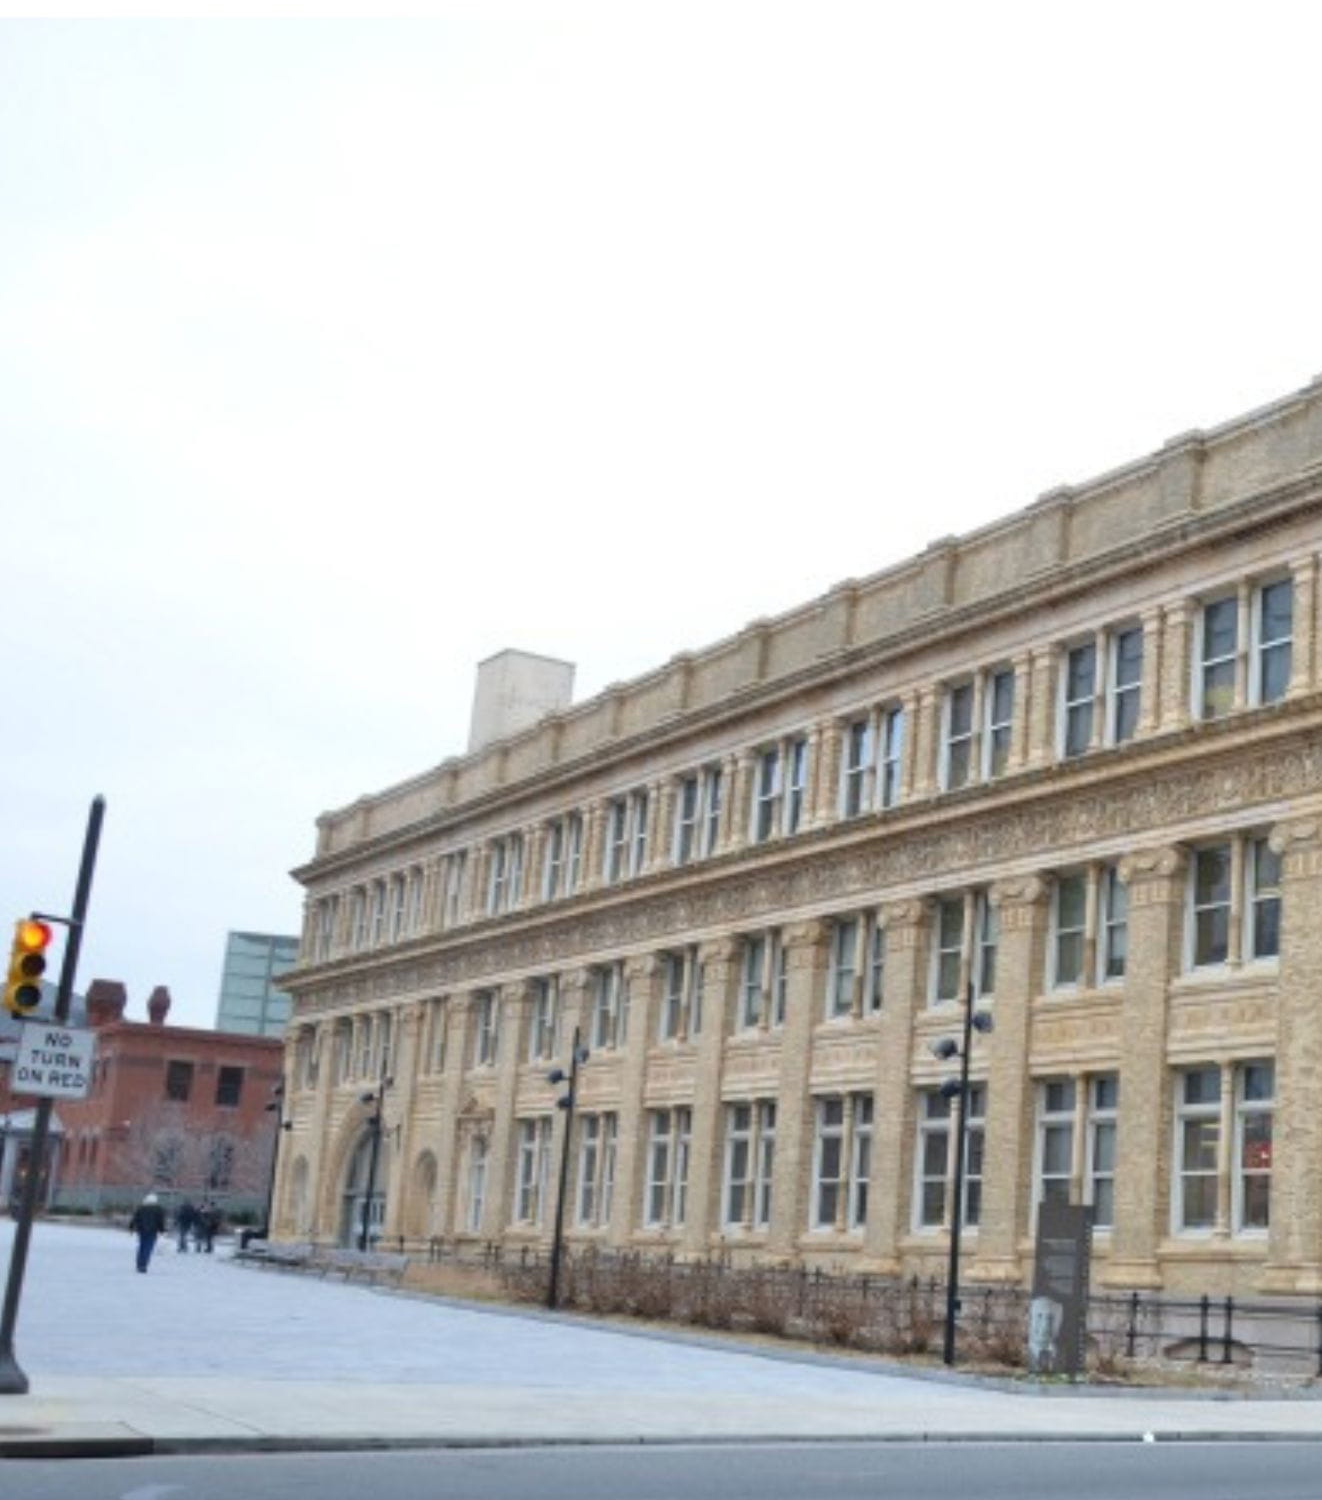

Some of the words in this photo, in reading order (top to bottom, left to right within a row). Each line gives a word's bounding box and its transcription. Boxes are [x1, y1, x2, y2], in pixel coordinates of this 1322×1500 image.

[45, 1033, 72, 1048] NO
[31, 1049, 80, 1069] TURN
[17, 1066, 42, 1083] ON
[48, 1069, 86, 1088] RED
